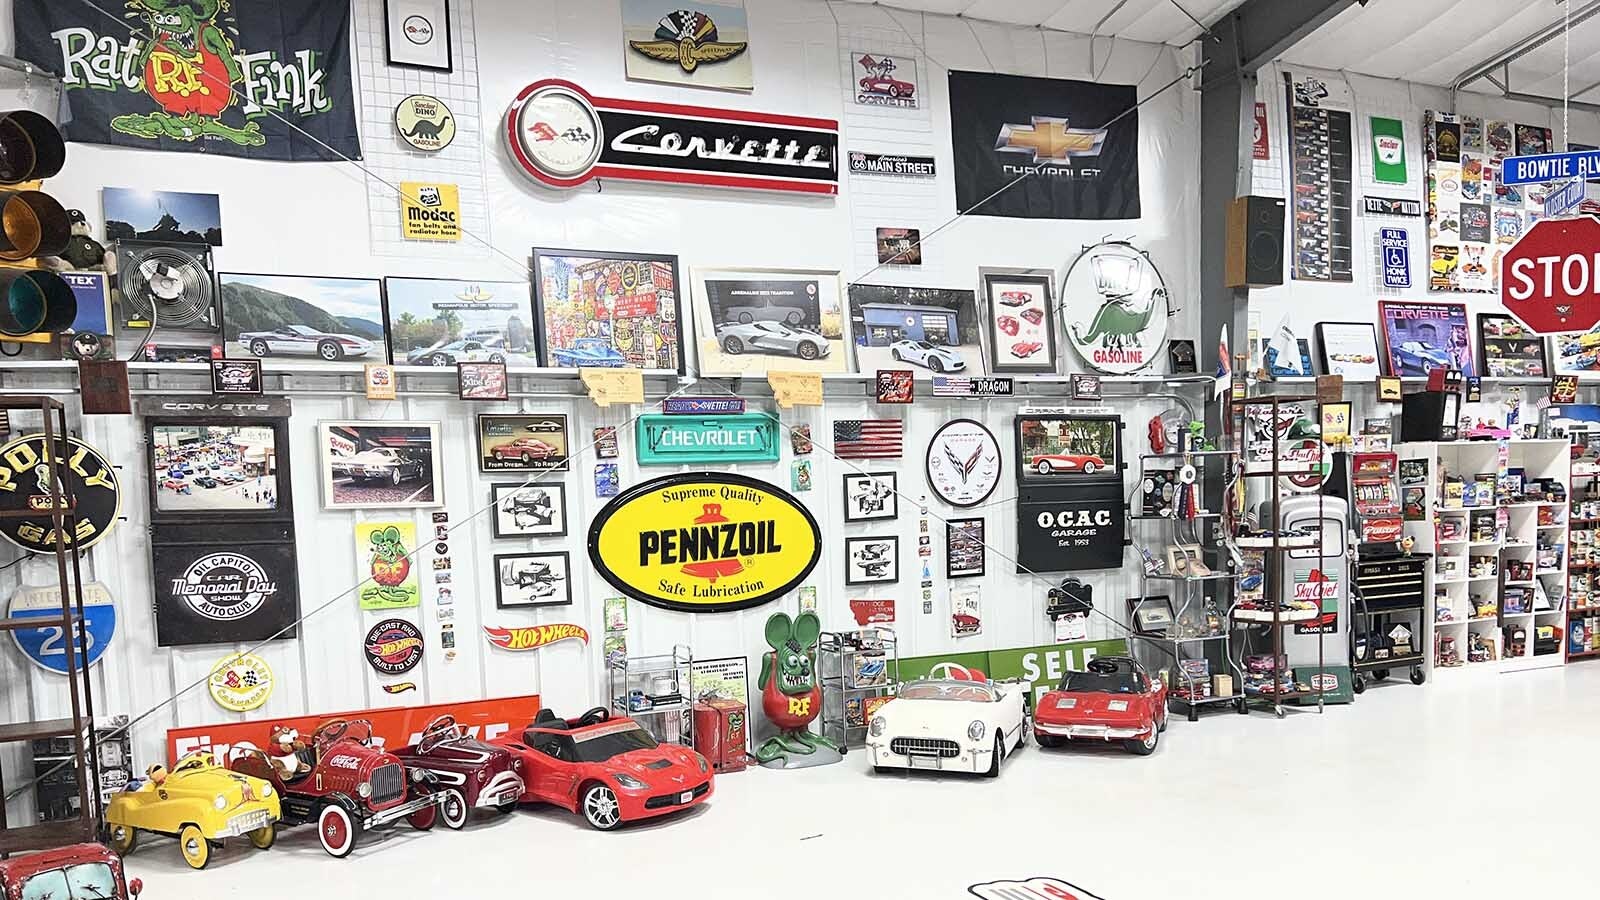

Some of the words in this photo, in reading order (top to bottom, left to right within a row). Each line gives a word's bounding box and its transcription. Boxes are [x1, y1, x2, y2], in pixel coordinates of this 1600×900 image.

[51, 27, 141, 90] Rat
[234, 50, 328, 114] Fink
[857, 95, 917, 108] CORVETTE
[415, 108, 436, 117] DINO
[412, 139, 441, 147] GASOLINE
[610, 125, 830, 168] Corvette
[854, 160, 866, 169] 66
[868, 160, 893, 172] MAIN
[895, 162, 933, 174] STREET
[1517, 157, 1571, 180] BOWTIE
[408, 206, 455, 221] Modac
[1386, 231, 1401, 239] FULL
[1501, 222, 1517, 236] 09
[1382, 238, 1408, 248] SERVICE
[1386, 267, 1407, 277] HONK
[1387, 276, 1408, 285] TWICE
[664, 311, 676, 319] 66
[1385, 308, 1450, 320] CORVETTE
[1094, 350, 1143, 363] GASOLINE
[978, 380, 1010, 392] DRAGON
[162, 402, 270, 411] CORVETTE
[662, 430, 757, 446] CHEVROLET
[0, 440, 115, 491] POLLY
[662, 487, 716, 504] Supreme
[719, 486, 765, 506] Quality
[17, 518, 97, 545] GAS
[1051, 529, 1097, 537] GARAGE
[639, 519, 782, 567] PENNZOIL
[193, 563, 210, 577] OIL
[211, 557, 256, 577] CAPITOL
[171, 579, 243, 595] Memorial
[245, 576, 278, 595] Day
[657, 579, 690, 598] Safe
[692, 579, 765, 598] Lubrication
[1293, 583, 1313, 600] Sky
[1312, 582, 1338, 597] Cief
[25, 589, 101, 602] INTERTE
[199, 602, 226, 616] AUTO
[226, 601, 252, 616] CLUB
[37, 619, 95, 656] 25
[370, 622, 402, 641] DIE-CAST
[402, 624, 416, 637] AND
[373, 656, 394, 671] BUILT
[405, 648, 420, 668] LAST
[1023, 648, 1098, 682] SELF
[330, 754, 362, 770] Coca-Cola
